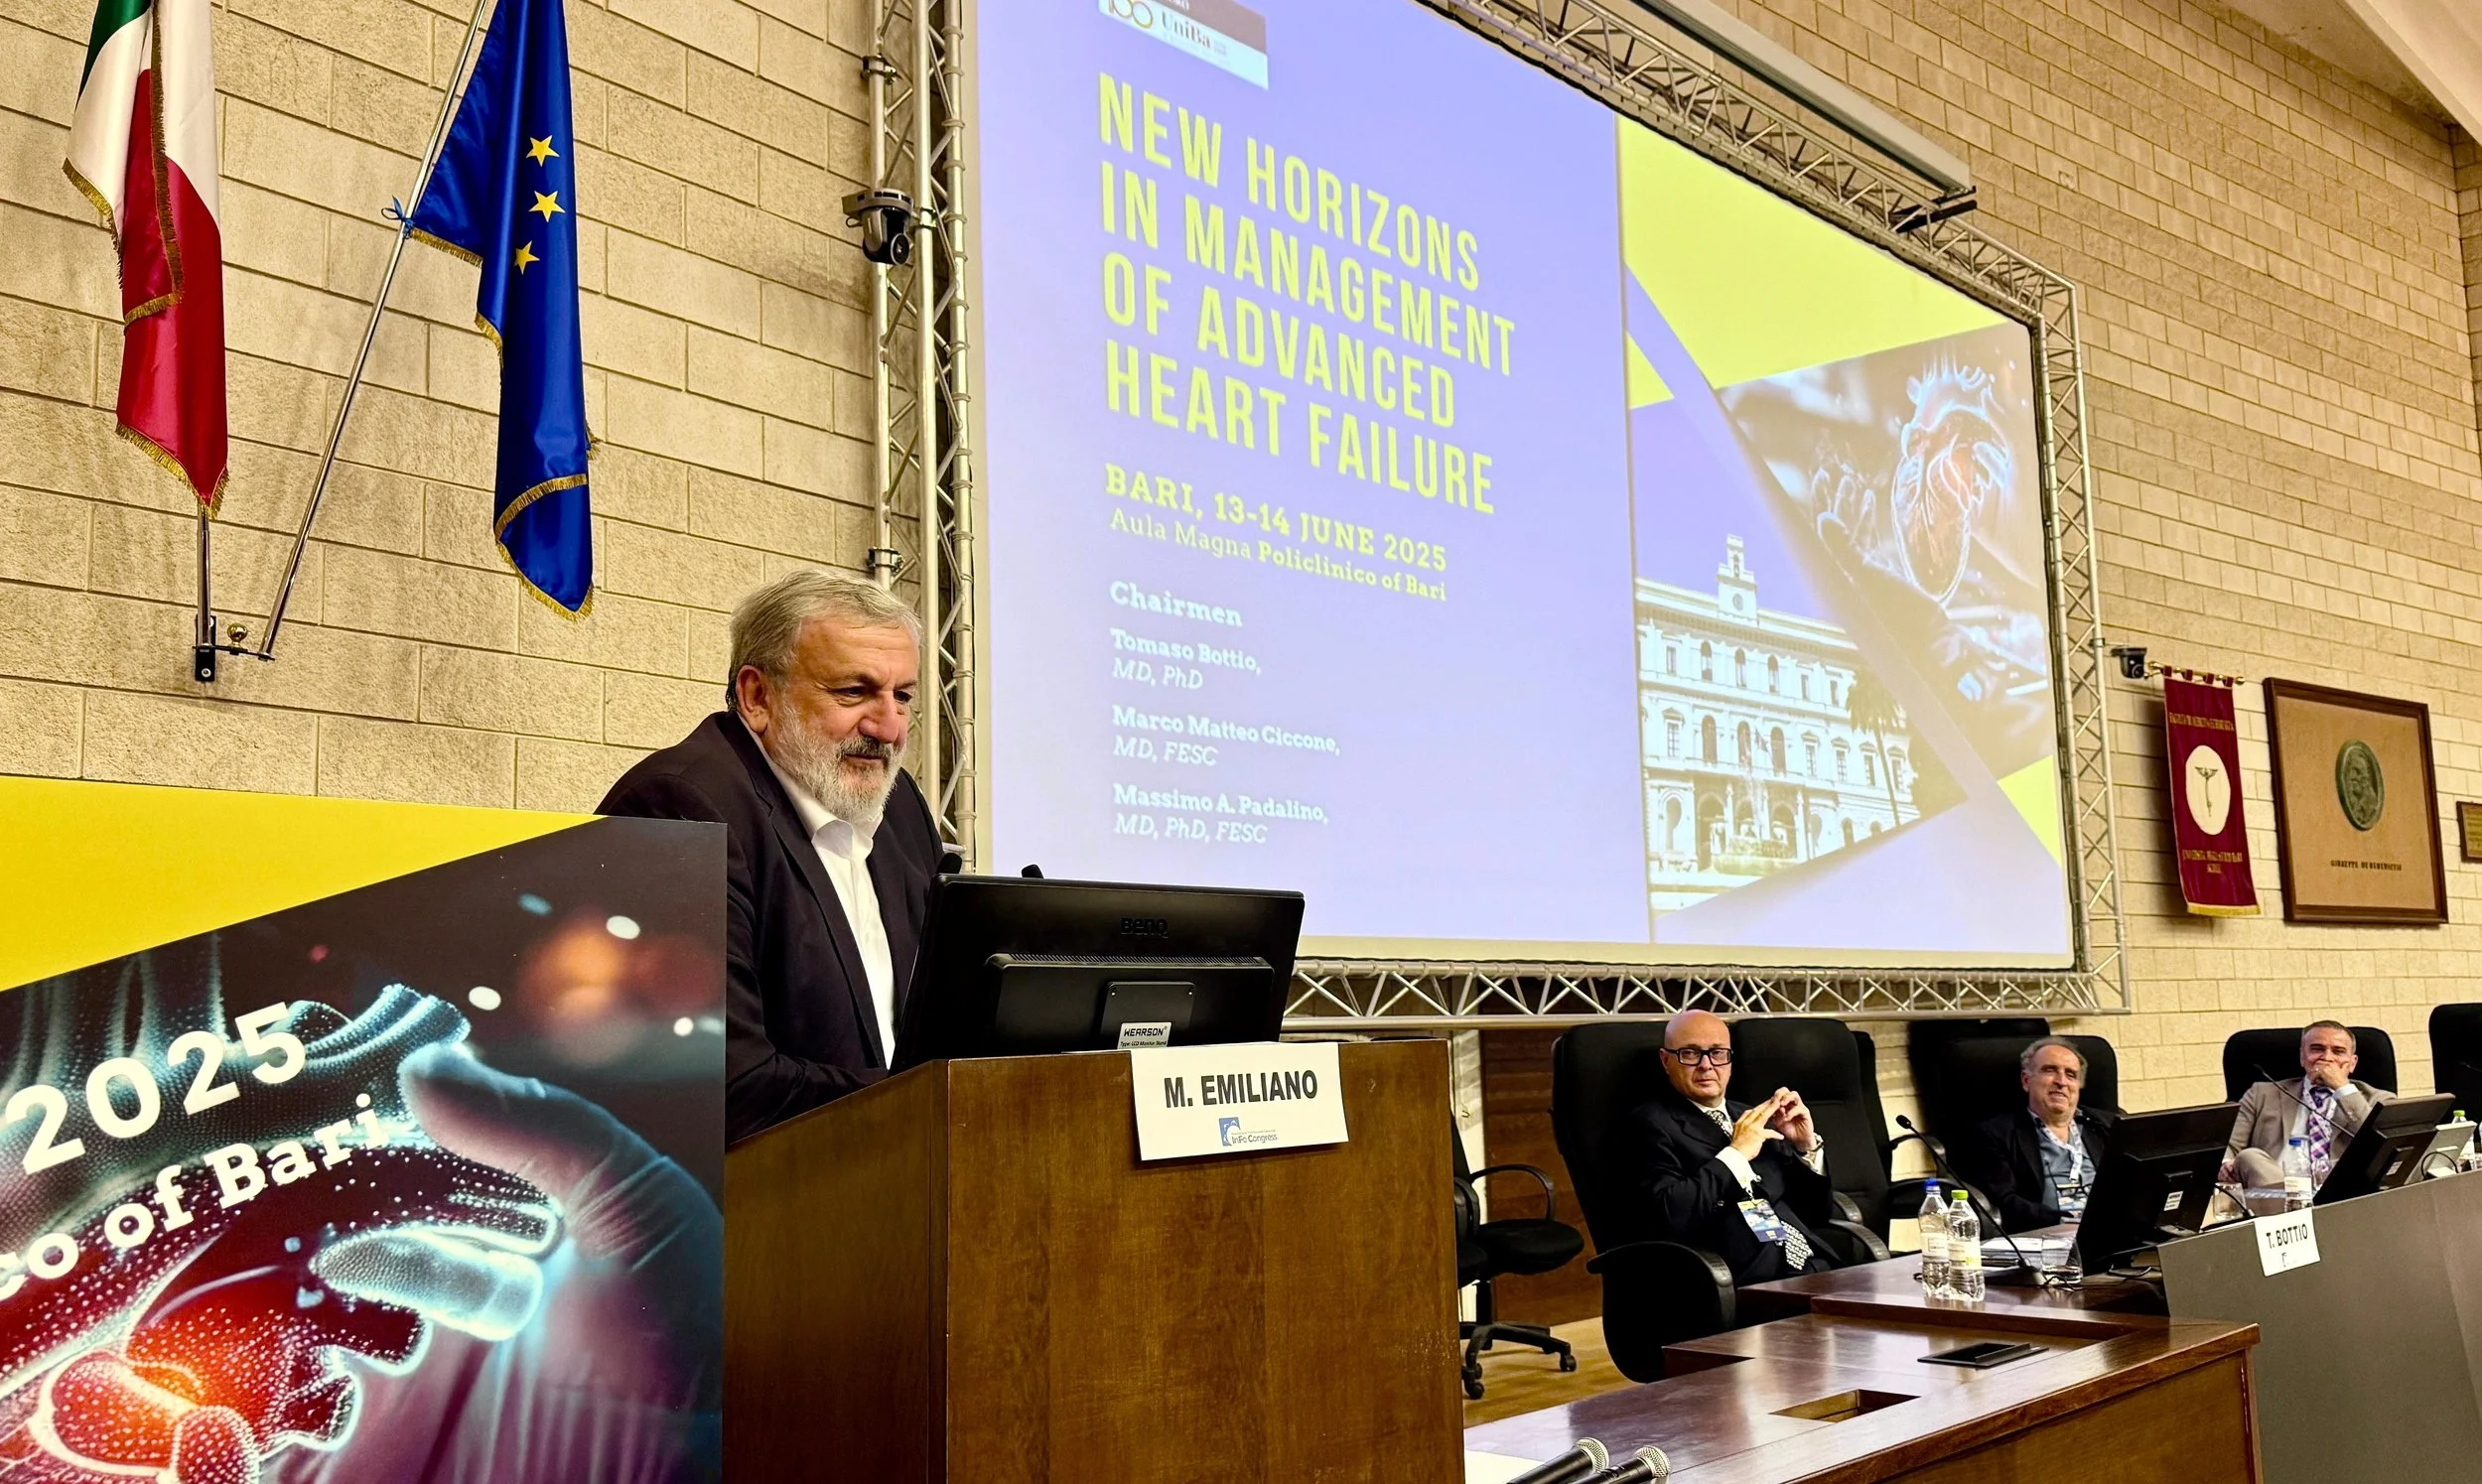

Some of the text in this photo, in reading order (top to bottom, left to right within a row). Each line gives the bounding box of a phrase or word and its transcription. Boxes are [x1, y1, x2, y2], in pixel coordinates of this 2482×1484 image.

[1162, 11, 1211, 48] UniBa
[1099, 71, 1478, 291] NEW HORIZONS
[1102, 161, 1515, 376] IN MANAGEMENT
[1103, 251, 1454, 428] OF ADVANCED
[1106, 338, 1494, 513] HEART FAILURE
[1105, 464, 1447, 572] BARI, 13-14 JUNE 2025
[1110, 507, 1447, 601] Aula Magna Policlinico of Bari
[1109, 581, 1243, 627] Chairmen
[1109, 627, 1261, 676] Tomaso Bottio,
[1112, 658, 1203, 690] MD, PhD
[1112, 704, 1340, 756] Marco Matteo Ciccone,
[1113, 736, 1219, 766] MD, FESC
[1112, 782, 1328, 824] Massimo A. Padalino,
[1114, 813, 1268, 845] MD, PhD, FESC
[5, 1002, 306, 1175] 2025
[1164, 1069, 1318, 1108] M. EMILIANO
[1248, 1133, 1279, 1144] Congress
[104, 1165, 195, 1248] of
[204, 1093, 390, 1210] Bari
[2266, 1223, 2308, 1249] T. BOTTIO
